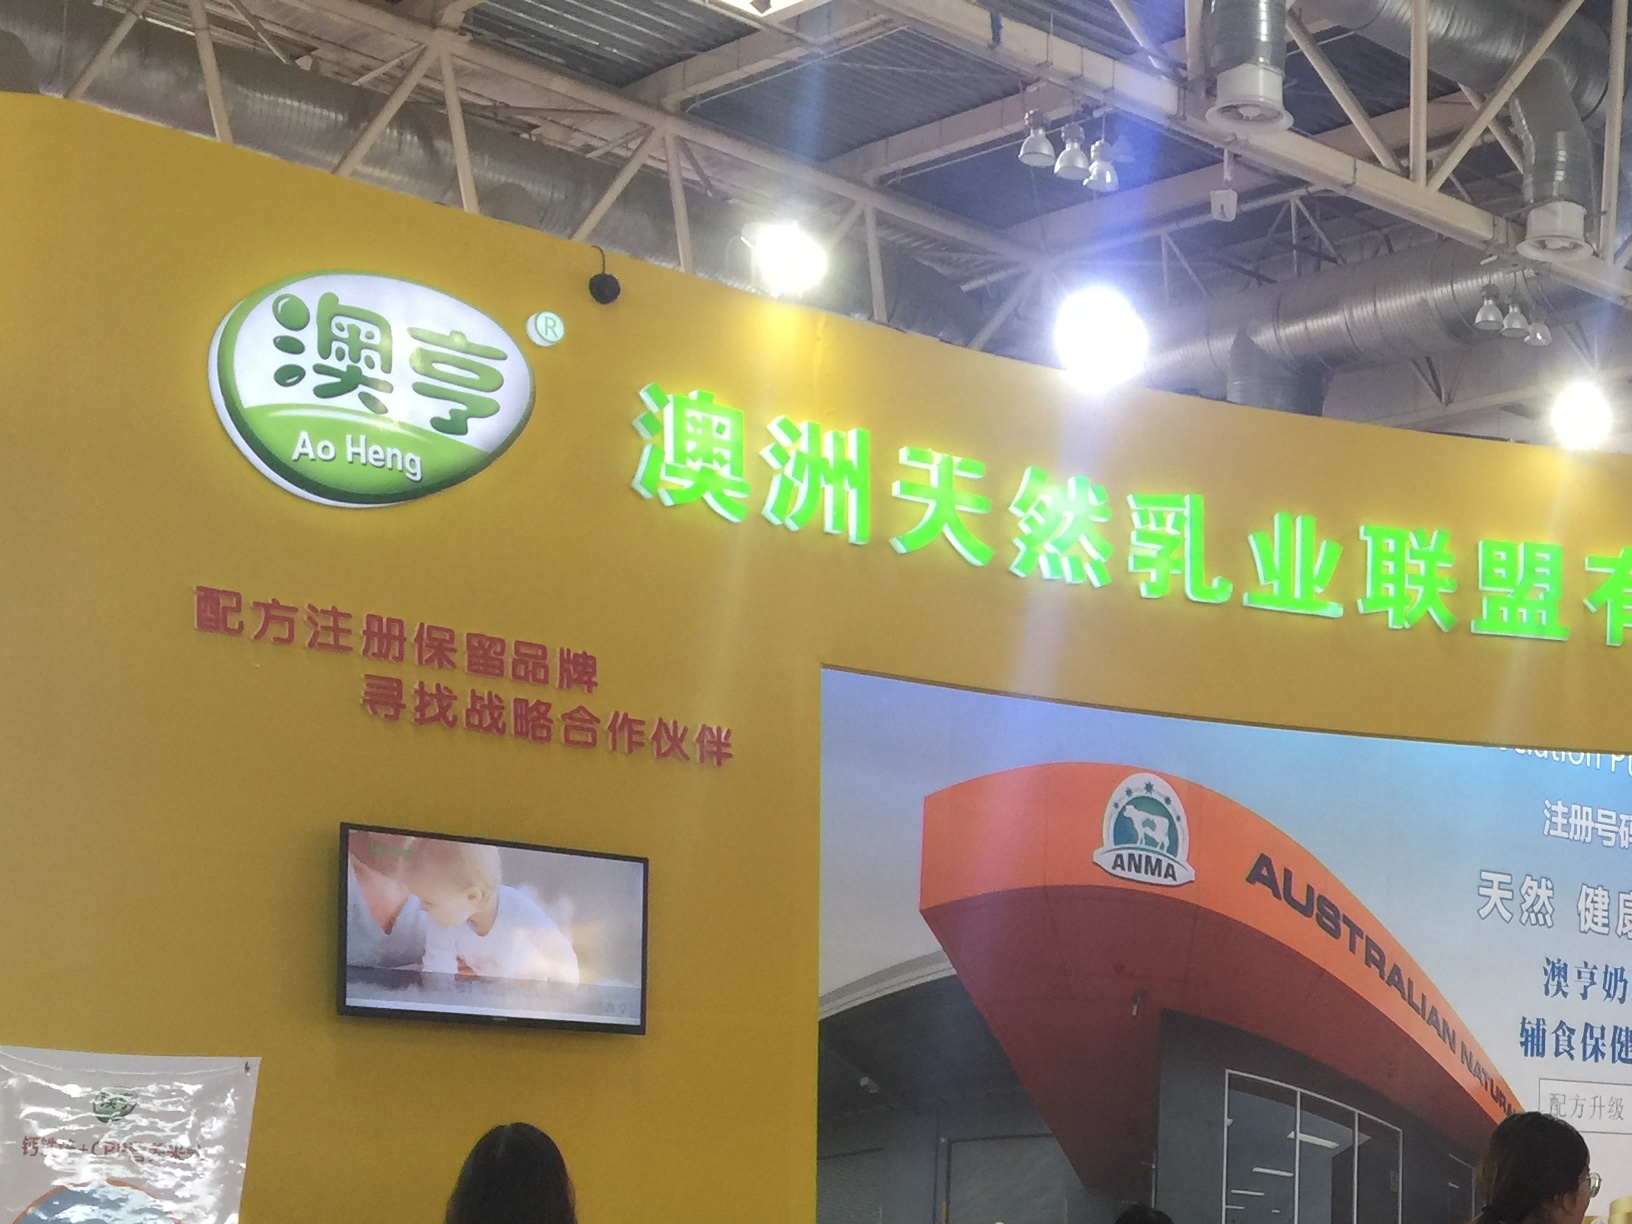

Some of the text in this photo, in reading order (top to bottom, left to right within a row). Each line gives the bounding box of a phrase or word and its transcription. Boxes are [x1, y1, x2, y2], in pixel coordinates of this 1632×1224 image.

[272, 292, 508, 435] 澳亨
[292, 431, 423, 482] Ao Heng
[193, 585, 598, 692] 配方注册保留品牌
[362, 672, 734, 767] 寻找战略合作伙伴
[1112, 852, 1178, 881] ANMA
[1478, 870, 1555, 928] 天然
[1246, 852, 1457, 1054] AUSTRALIAN
[1549, 1093, 1624, 1121] 配方升级
